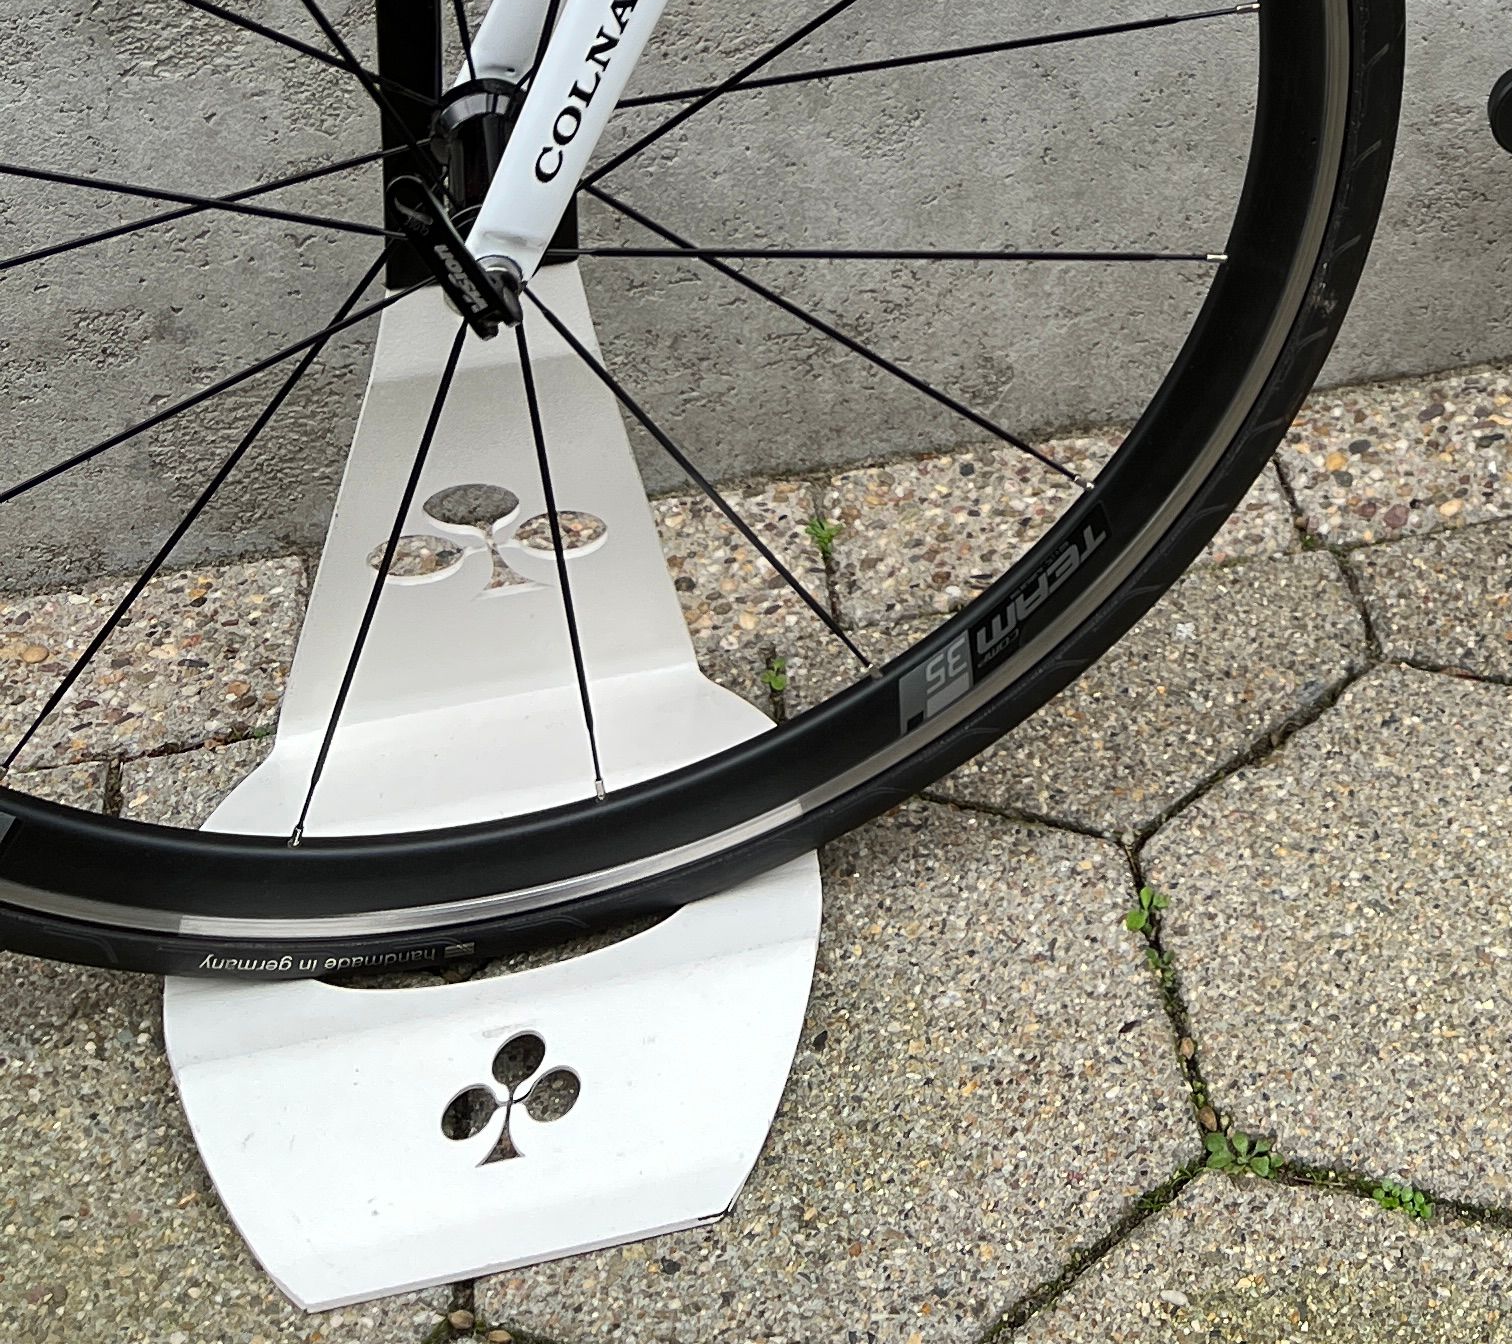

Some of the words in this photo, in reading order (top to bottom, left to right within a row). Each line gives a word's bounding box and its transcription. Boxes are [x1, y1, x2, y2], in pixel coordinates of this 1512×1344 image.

[199, 953, 292, 972] germany
[299, 958, 318, 973] in
[325, 948, 436, 971] handmade
